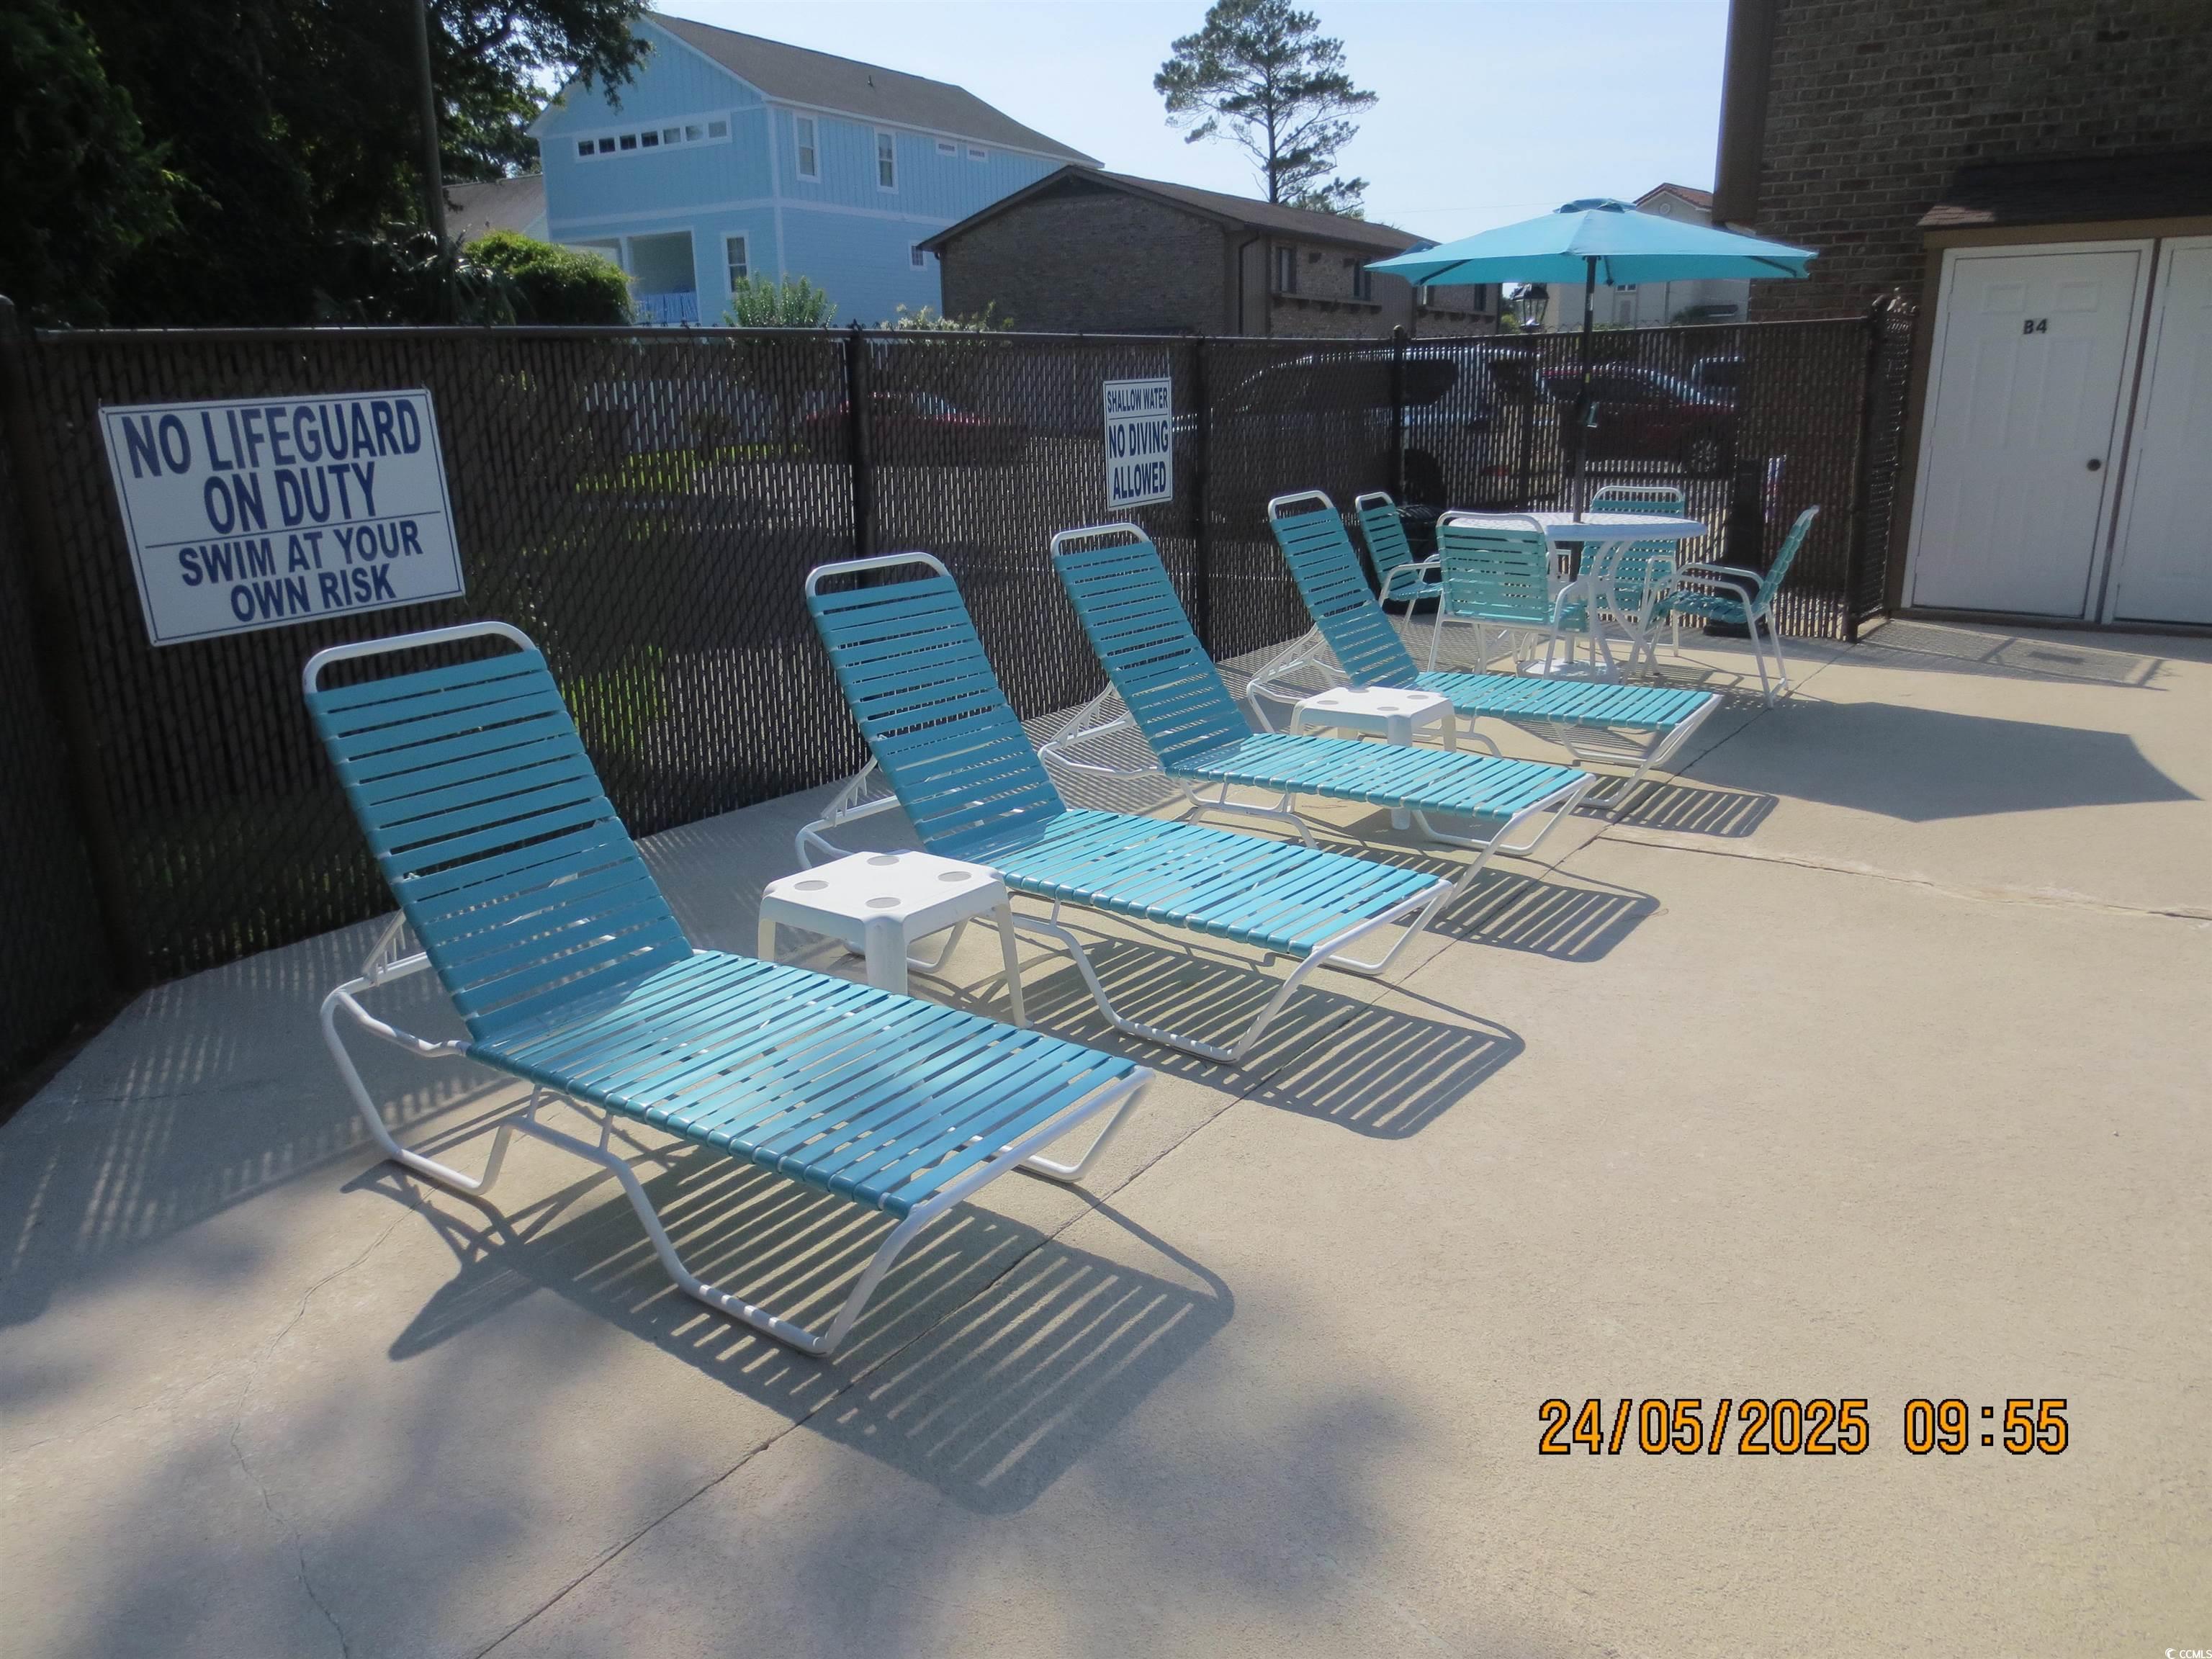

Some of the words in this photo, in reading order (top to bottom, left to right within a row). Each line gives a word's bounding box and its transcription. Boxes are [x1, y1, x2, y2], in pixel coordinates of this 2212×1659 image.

[2023, 318, 2047, 335] B4
[1107, 388, 1141, 413] SHALLOW
[1143, 387, 1168, 410] WATER
[122, 414, 192, 478] NO
[201, 399, 421, 471] LIFEGUARD
[1109, 424, 1125, 459] NO
[1129, 420, 1169, 457] DIVING
[203, 472, 268, 535] ON
[275, 462, 376, 527] DUTY
[1113, 461, 1166, 500] ALLOWED
[179, 538, 276, 586] SWIM
[288, 531, 323, 573] AT
[333, 520, 423, 565] YOUR
[230, 576, 311, 623] OWN
[320, 563, 396, 609] RISK
